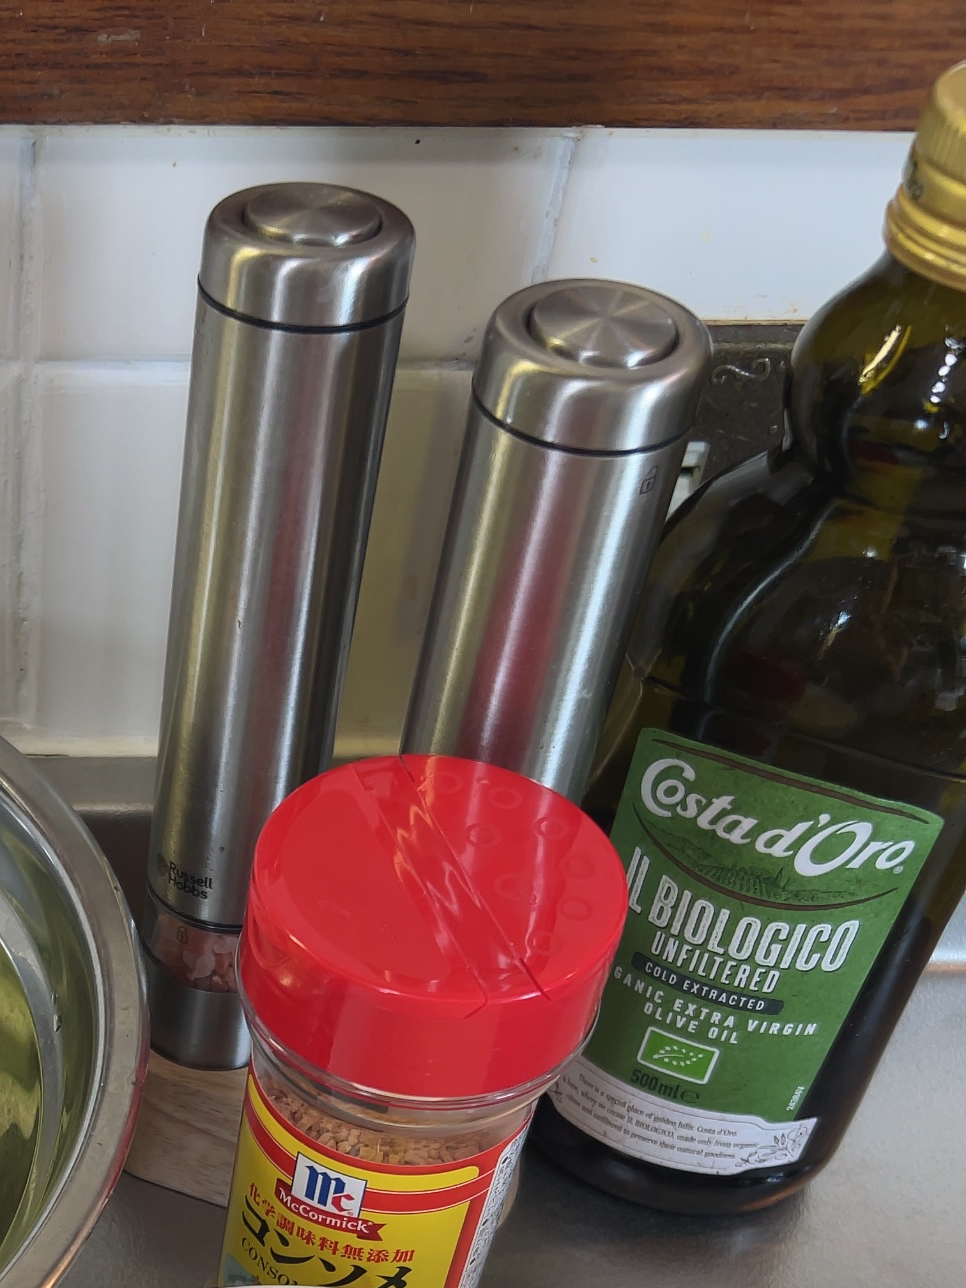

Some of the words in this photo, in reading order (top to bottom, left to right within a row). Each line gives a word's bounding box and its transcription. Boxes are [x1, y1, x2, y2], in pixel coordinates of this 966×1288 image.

[641, 758, 758, 844] Costa
[755, 814, 915, 876] d'Oro
[169, 861, 213, 889] Russell
[169, 873, 208, 899] Hobbs
[627, 846, 650, 914] IL
[648, 874, 860, 972] BIOLOGICO
[645, 962, 677, 985] COLD
[682, 977, 766, 1011] EXTRACTED
[651, 931, 780, 994] UNFILTERED
[613, 965, 664, 1003] GANIC
[672, 999, 735, 1028] EXTRA
[747, 1020, 817, 1036] VIRGIN
[644, 1003, 699, 1033] OLIVE
[707, 1027, 738, 1044] OIL
[249, 1182, 415, 1263] 化学調味料無添加
[279, 1187, 369, 1234] McCormick
[242, 1238, 298, 1286] CONSO
